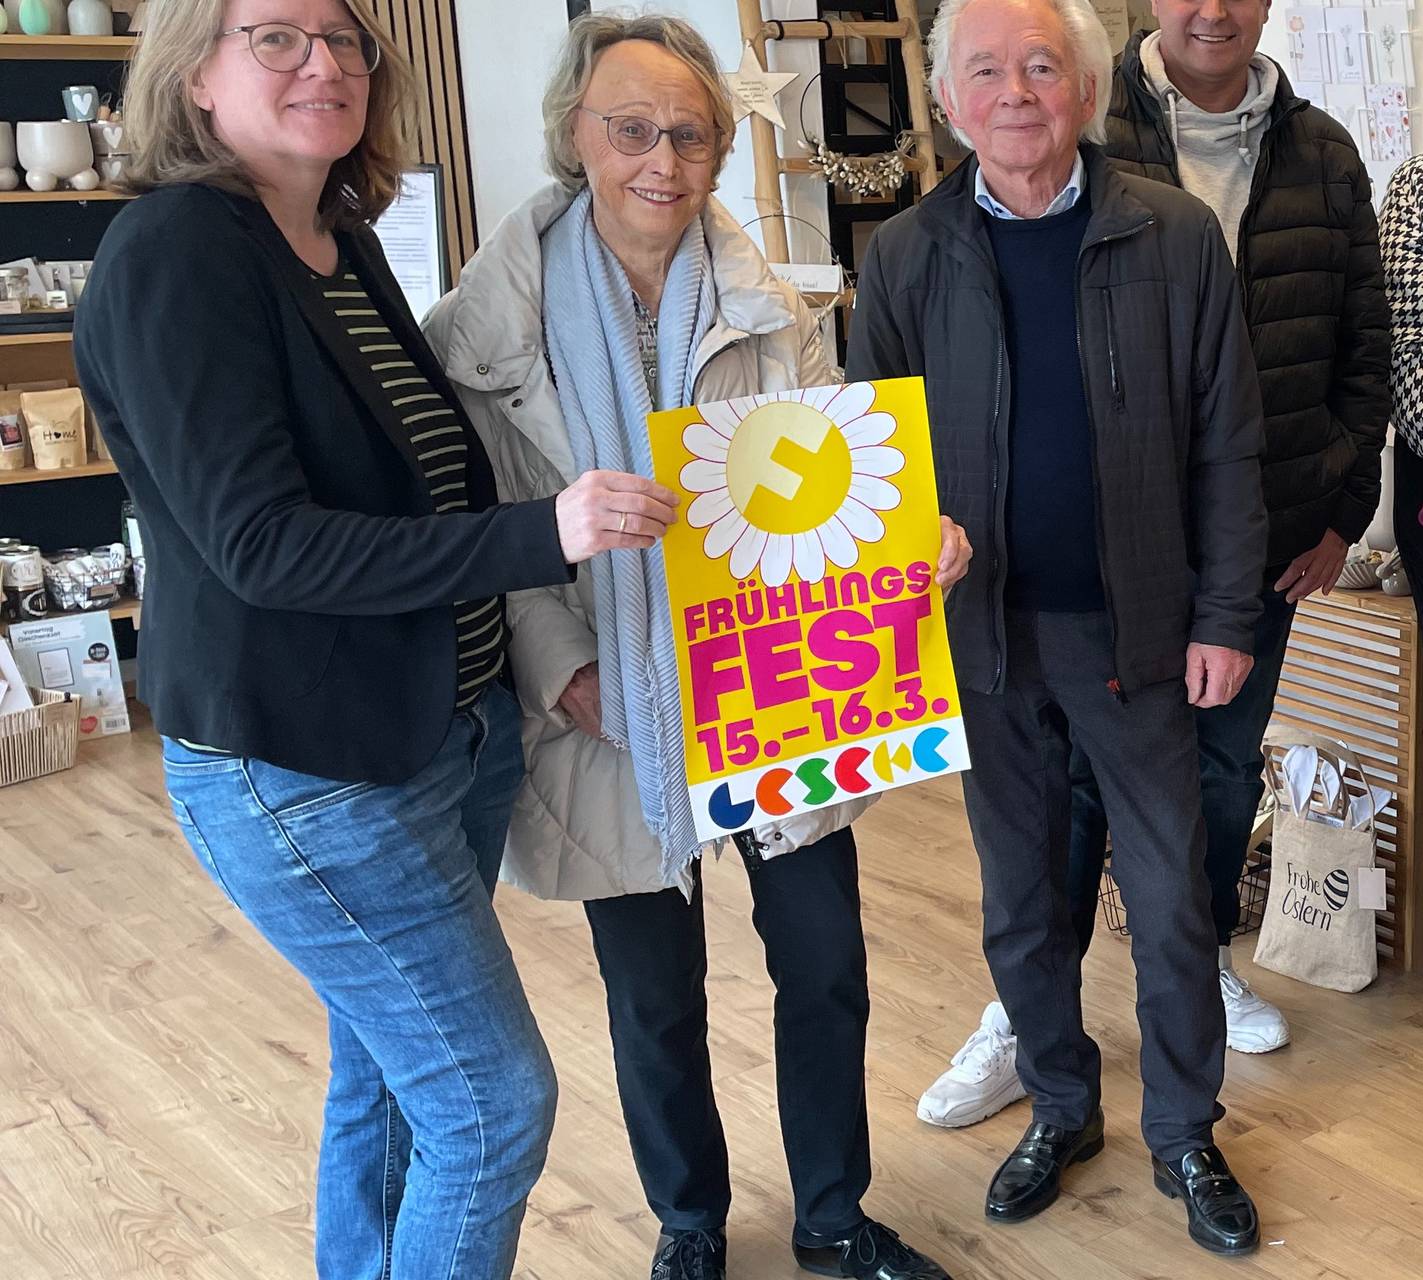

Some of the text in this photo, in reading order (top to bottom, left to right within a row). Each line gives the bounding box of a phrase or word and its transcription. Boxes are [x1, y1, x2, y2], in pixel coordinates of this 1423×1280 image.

[688, 594, 933, 727] FEST
[1287, 862, 1321, 896] Frohe
[1282, 887, 1333, 932] Ostern
